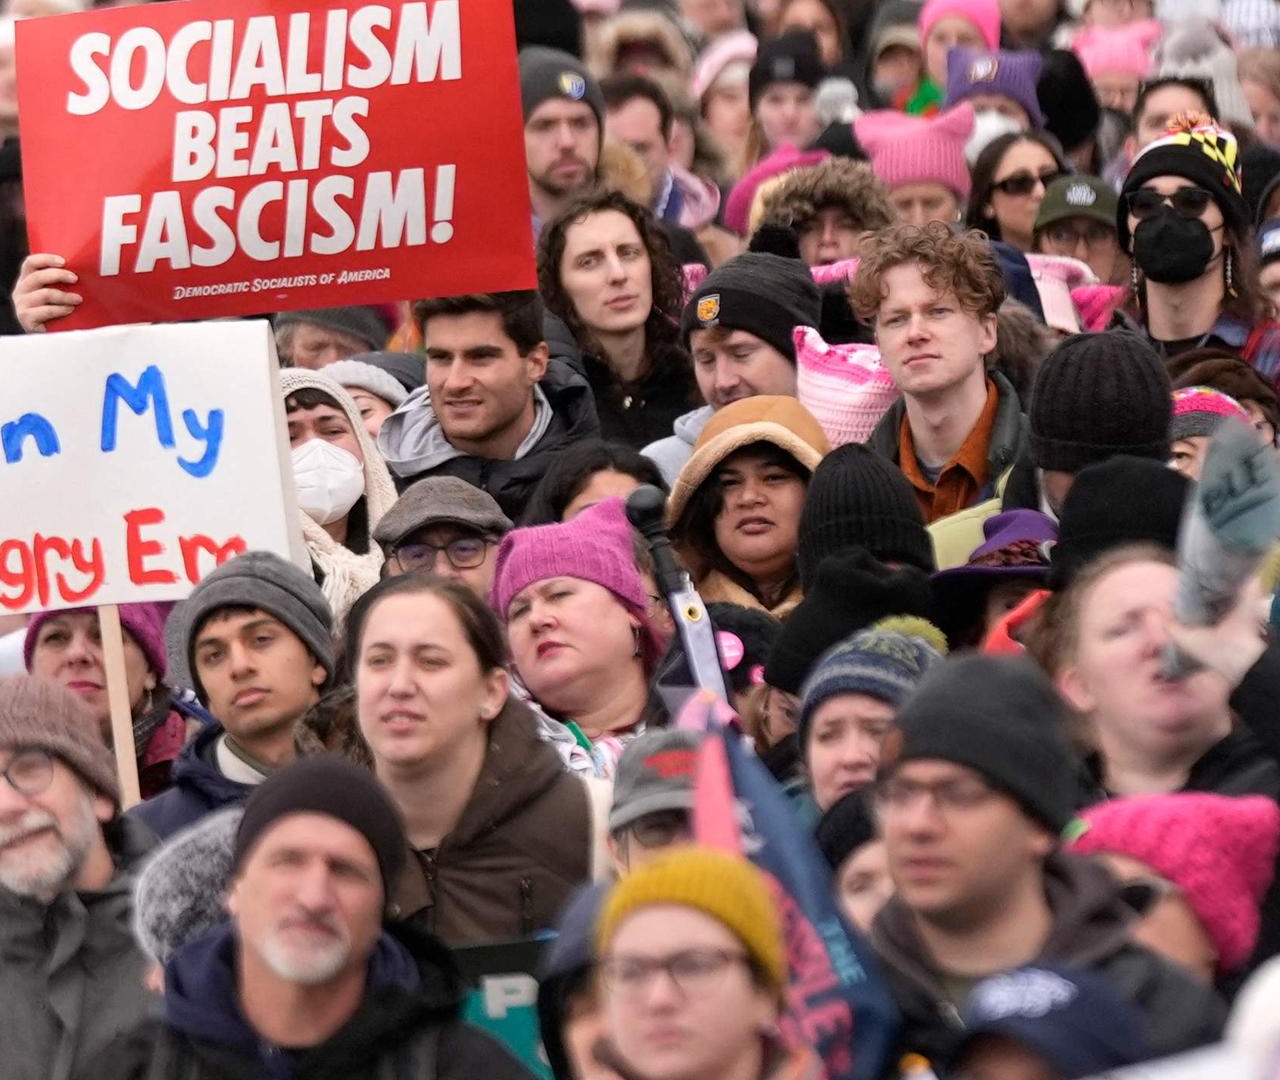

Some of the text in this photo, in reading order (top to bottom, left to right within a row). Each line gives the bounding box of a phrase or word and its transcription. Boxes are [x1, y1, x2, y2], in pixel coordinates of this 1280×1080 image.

[66, 0, 462, 116] SOCIALISM
[172, 96, 370, 182] BEATS
[100, 163, 457, 277] FASCISM!
[100, 364, 224, 478] My
